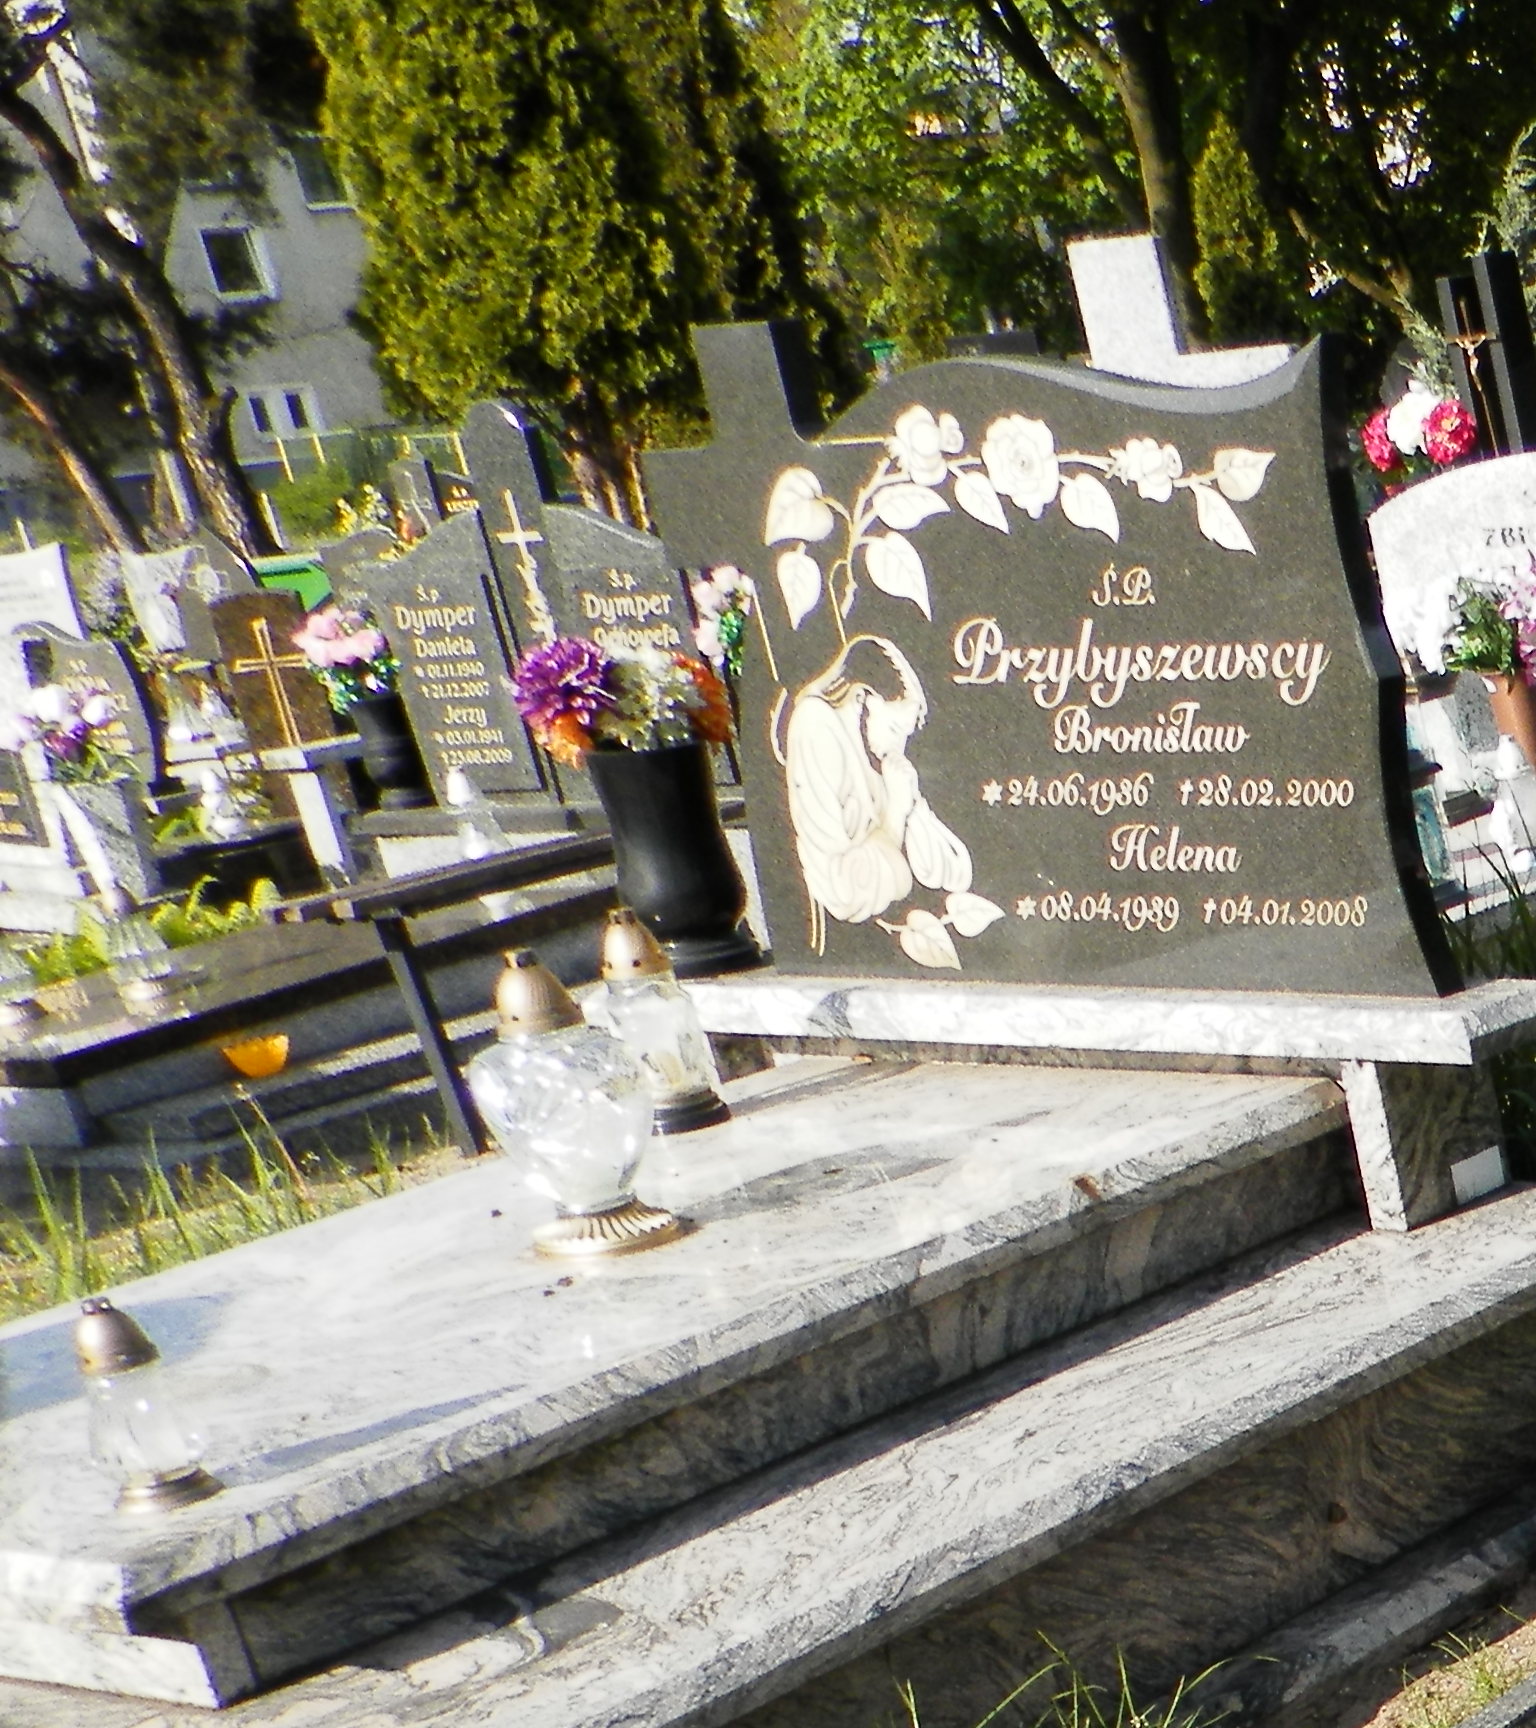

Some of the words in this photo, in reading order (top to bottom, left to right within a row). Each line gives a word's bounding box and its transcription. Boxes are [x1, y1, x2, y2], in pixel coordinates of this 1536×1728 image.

[394, 605, 476, 635] Dymper
[583, 592, 673, 625] Dymper
[414, 636, 477, 658] Daniela
[952, 616, 1333, 709] Przybyszewscy
[444, 704, 488, 729] Jerzy
[1198, 773, 1355, 808] 28.02.2000
[1109, 823, 1243, 874] Helena
[1220, 894, 1368, 928] 04.01.2008
